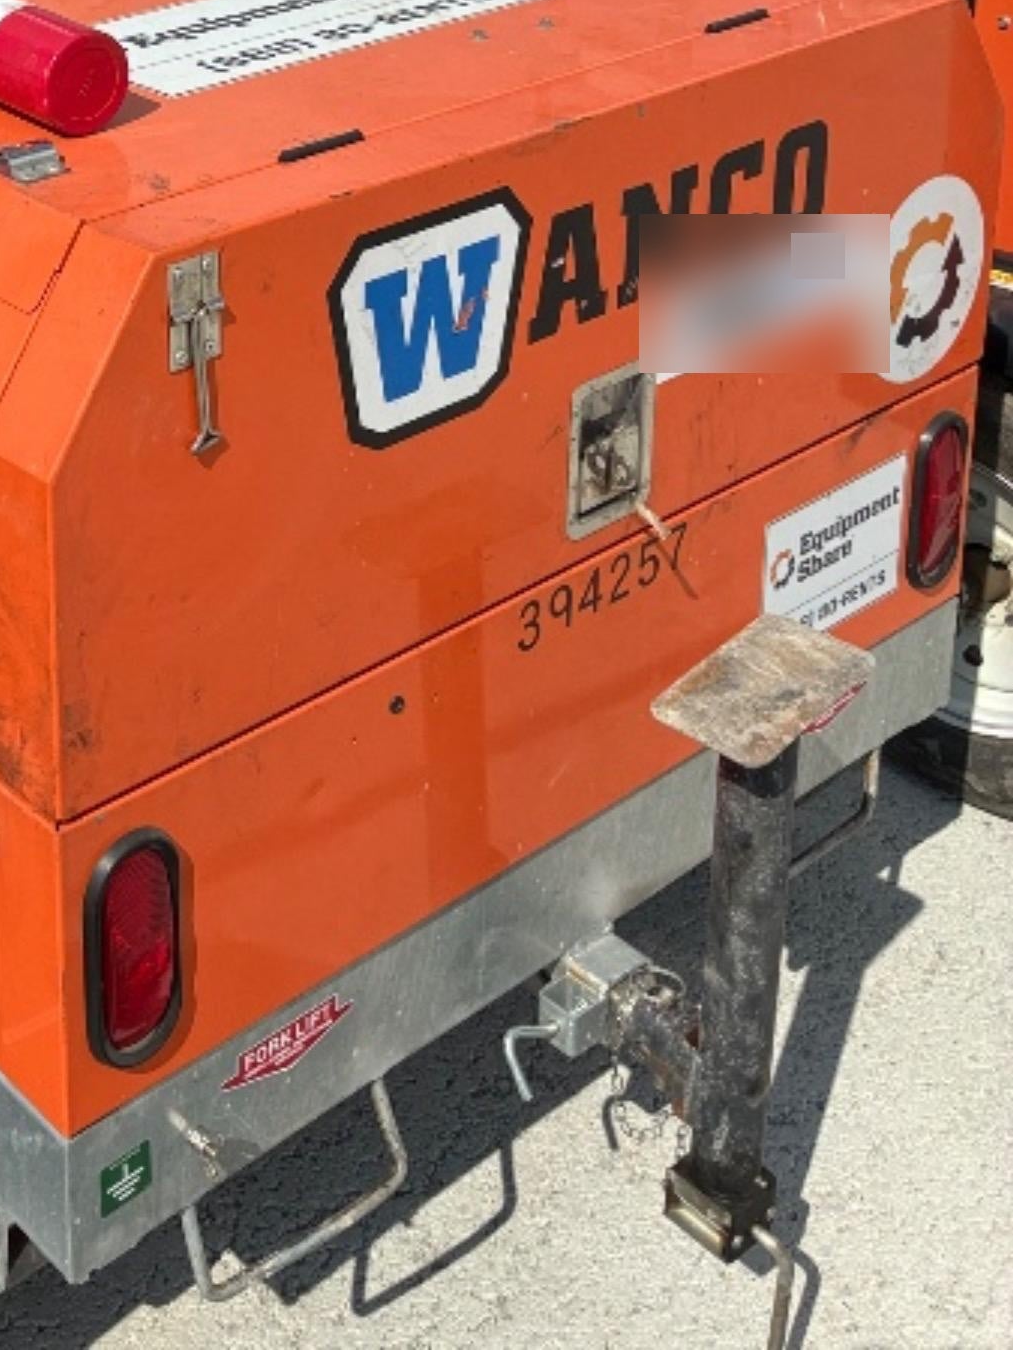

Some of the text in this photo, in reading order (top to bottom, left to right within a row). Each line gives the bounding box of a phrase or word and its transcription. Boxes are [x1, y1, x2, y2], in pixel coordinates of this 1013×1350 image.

[799, 486, 901, 557] Equipment
[517, 521, 687, 653] 394257
[796, 540, 853, 583] Share
[243, 1028, 292, 1072] FORK
